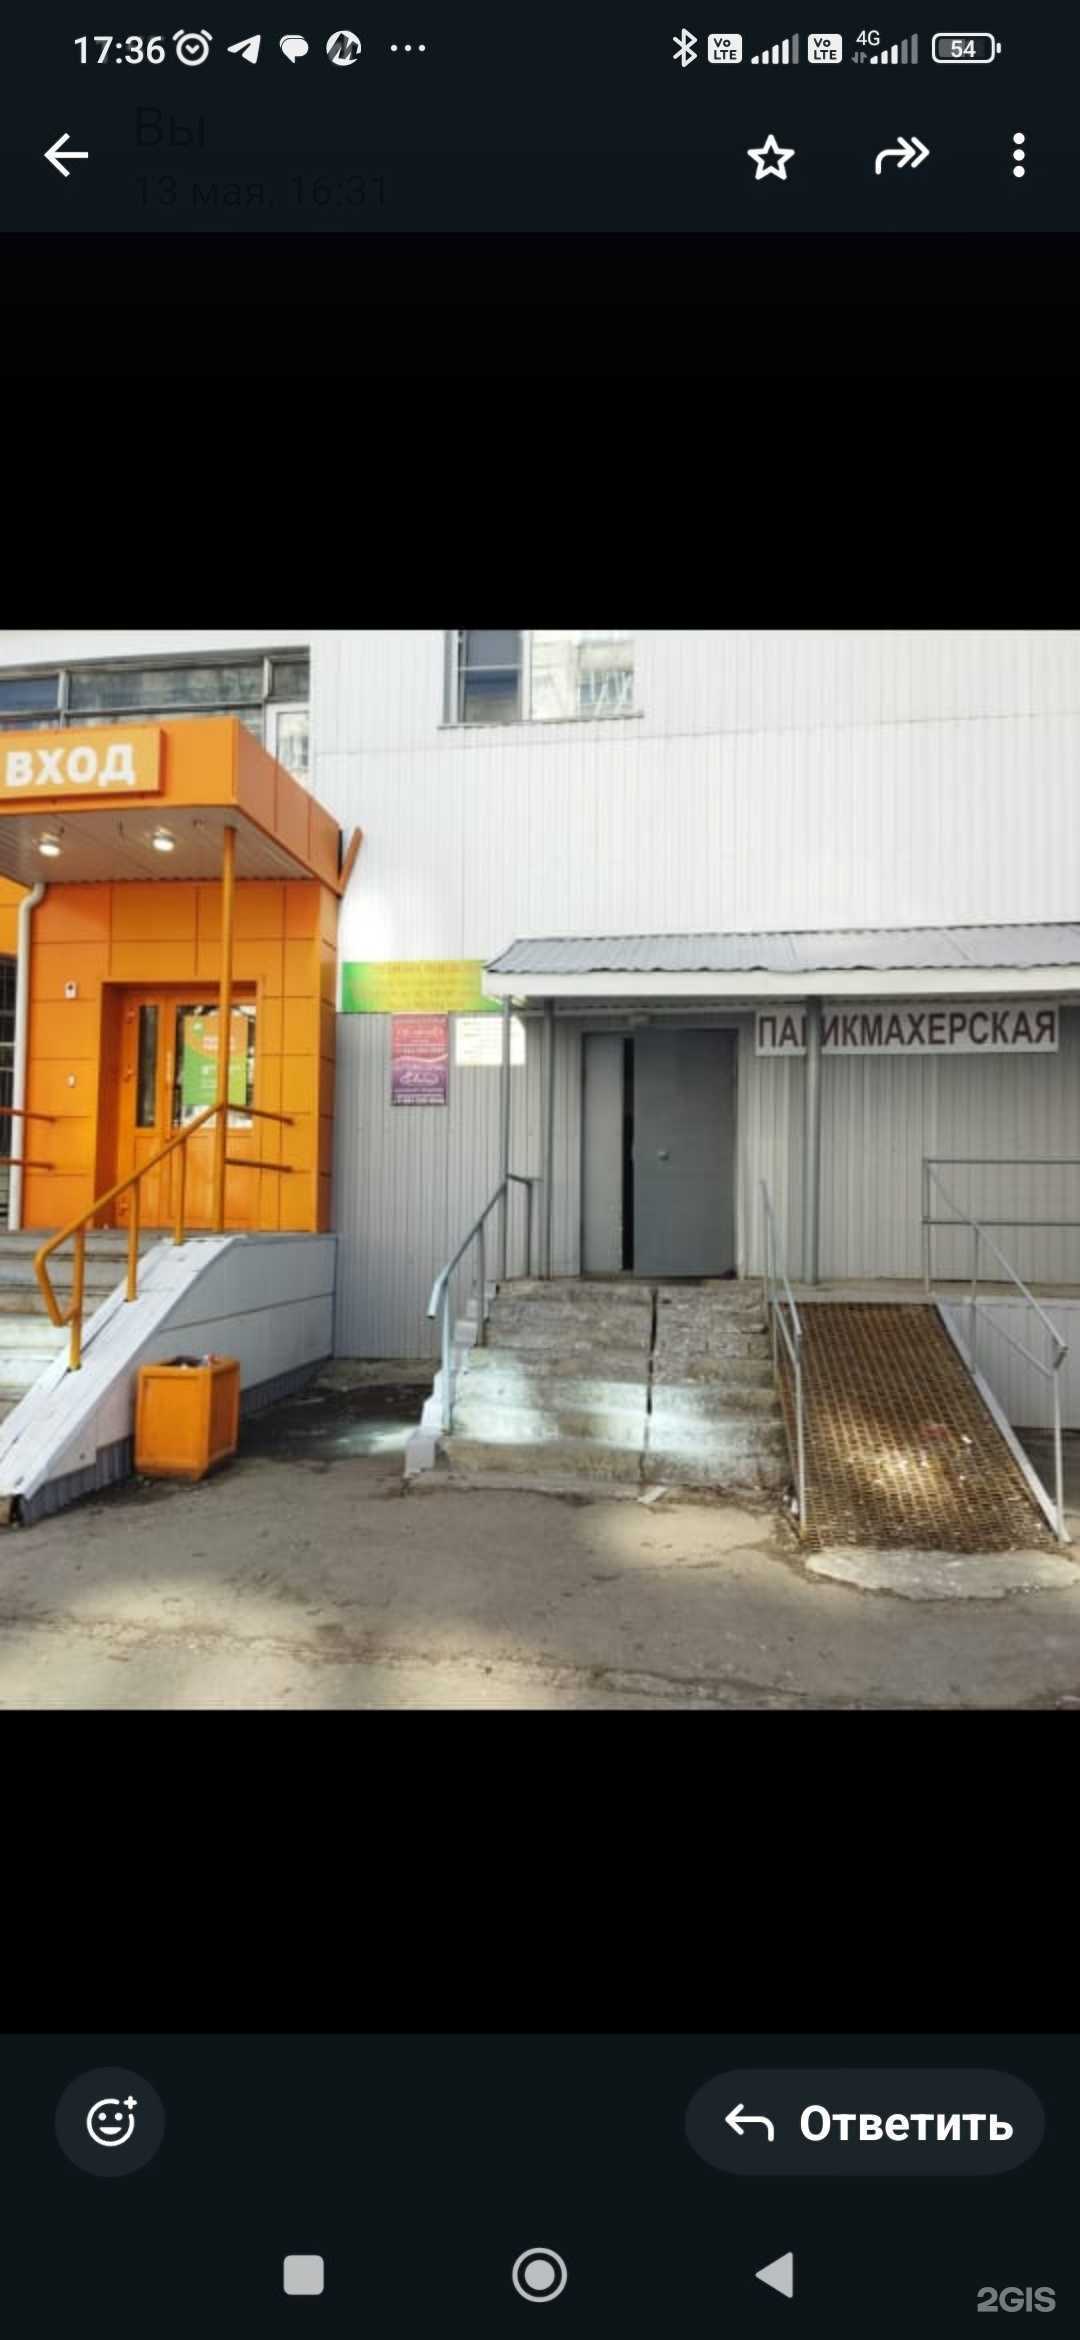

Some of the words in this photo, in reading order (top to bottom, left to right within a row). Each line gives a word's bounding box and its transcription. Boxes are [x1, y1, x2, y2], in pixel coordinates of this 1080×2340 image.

[713, 38, 731, 48] Vo
[813, 38, 831, 48] Vo
[856, 30, 880, 46] 4G
[74, 36, 165, 64] 17:36
[714, 50, 737, 60] LTE
[814, 50, 837, 60] LTE
[950, 40, 976, 58] 54
[5, 744, 136, 787] ВХОД
[759, 1011, 1055, 1048] ПАИКМАХЕРСКАЯ
[800, 2105, 1014, 2141] Ответить
